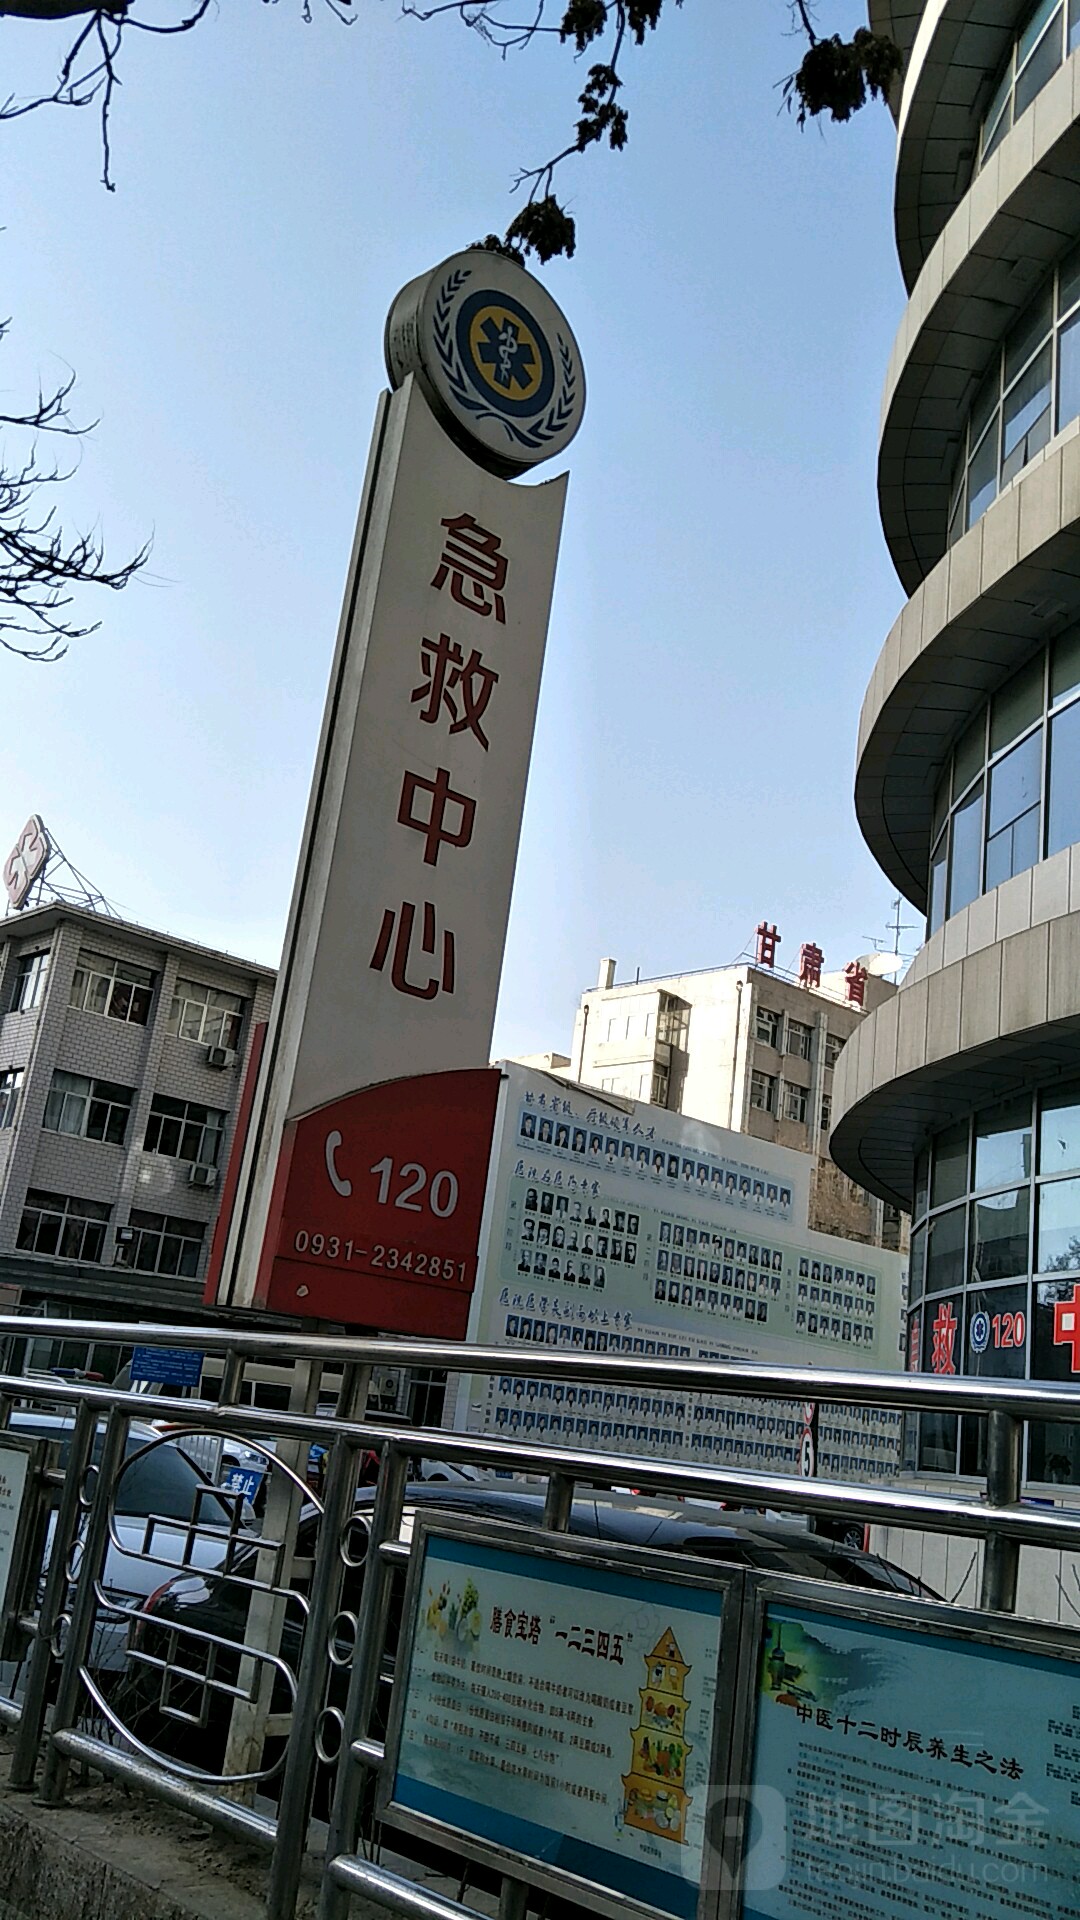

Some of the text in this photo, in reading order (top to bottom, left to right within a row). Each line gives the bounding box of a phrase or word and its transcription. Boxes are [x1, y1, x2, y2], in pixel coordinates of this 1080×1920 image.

[370, 513, 508, 1001] 急救中心
[756, 921, 869, 1007] 甘肃省
[370, 1156, 459, 1218] 120
[295, 1230, 467, 1283] 0931-2342851
[991, 1310, 1026, 1348] 120
[230, 1472, 255, 1497] 禁止
[796, 1705, 1024, 1780] 中医十二时辰养生之法
